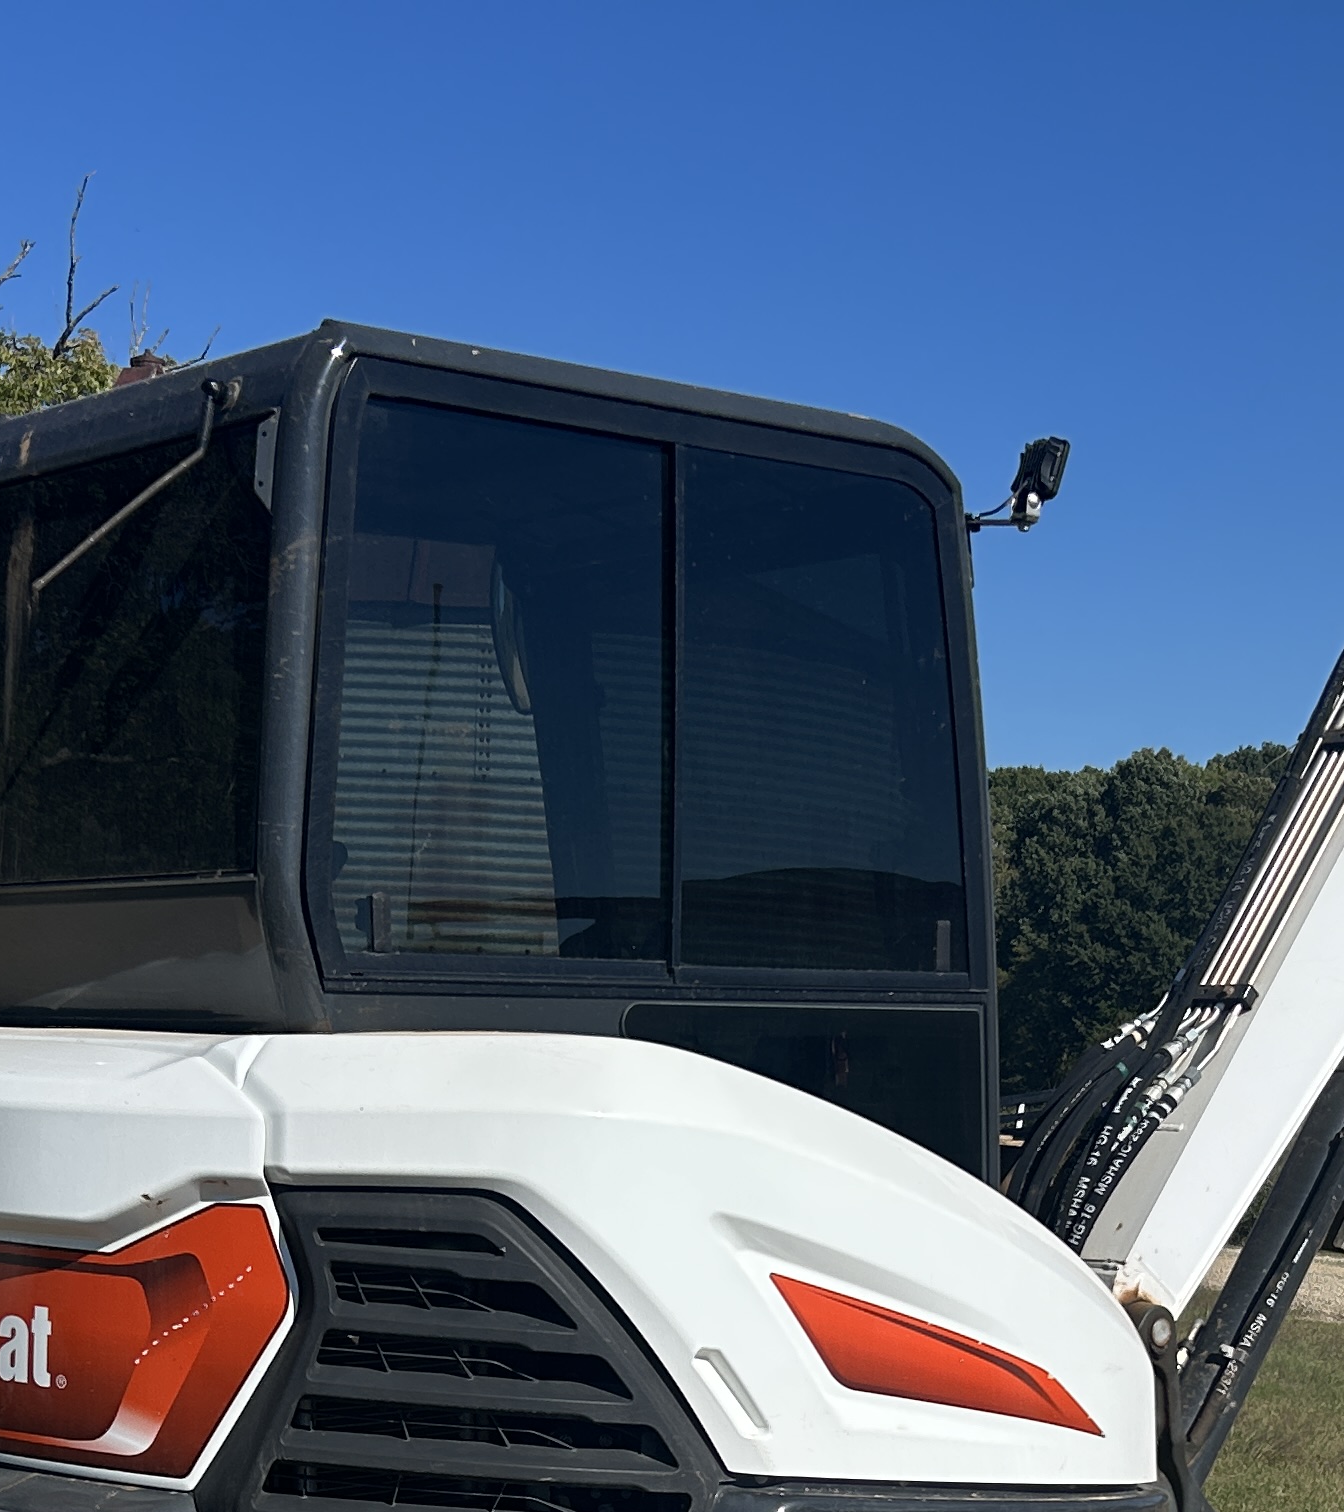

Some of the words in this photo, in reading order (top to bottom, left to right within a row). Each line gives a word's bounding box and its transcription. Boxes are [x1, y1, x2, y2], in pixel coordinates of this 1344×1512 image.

[1067, 1176, 1091, 1217] MSHA
[1067, 1203, 1096, 1246] HG-16
[1093, 1158, 1124, 1196] MSHA
[1238, 1312, 1267, 1348] MSHA
